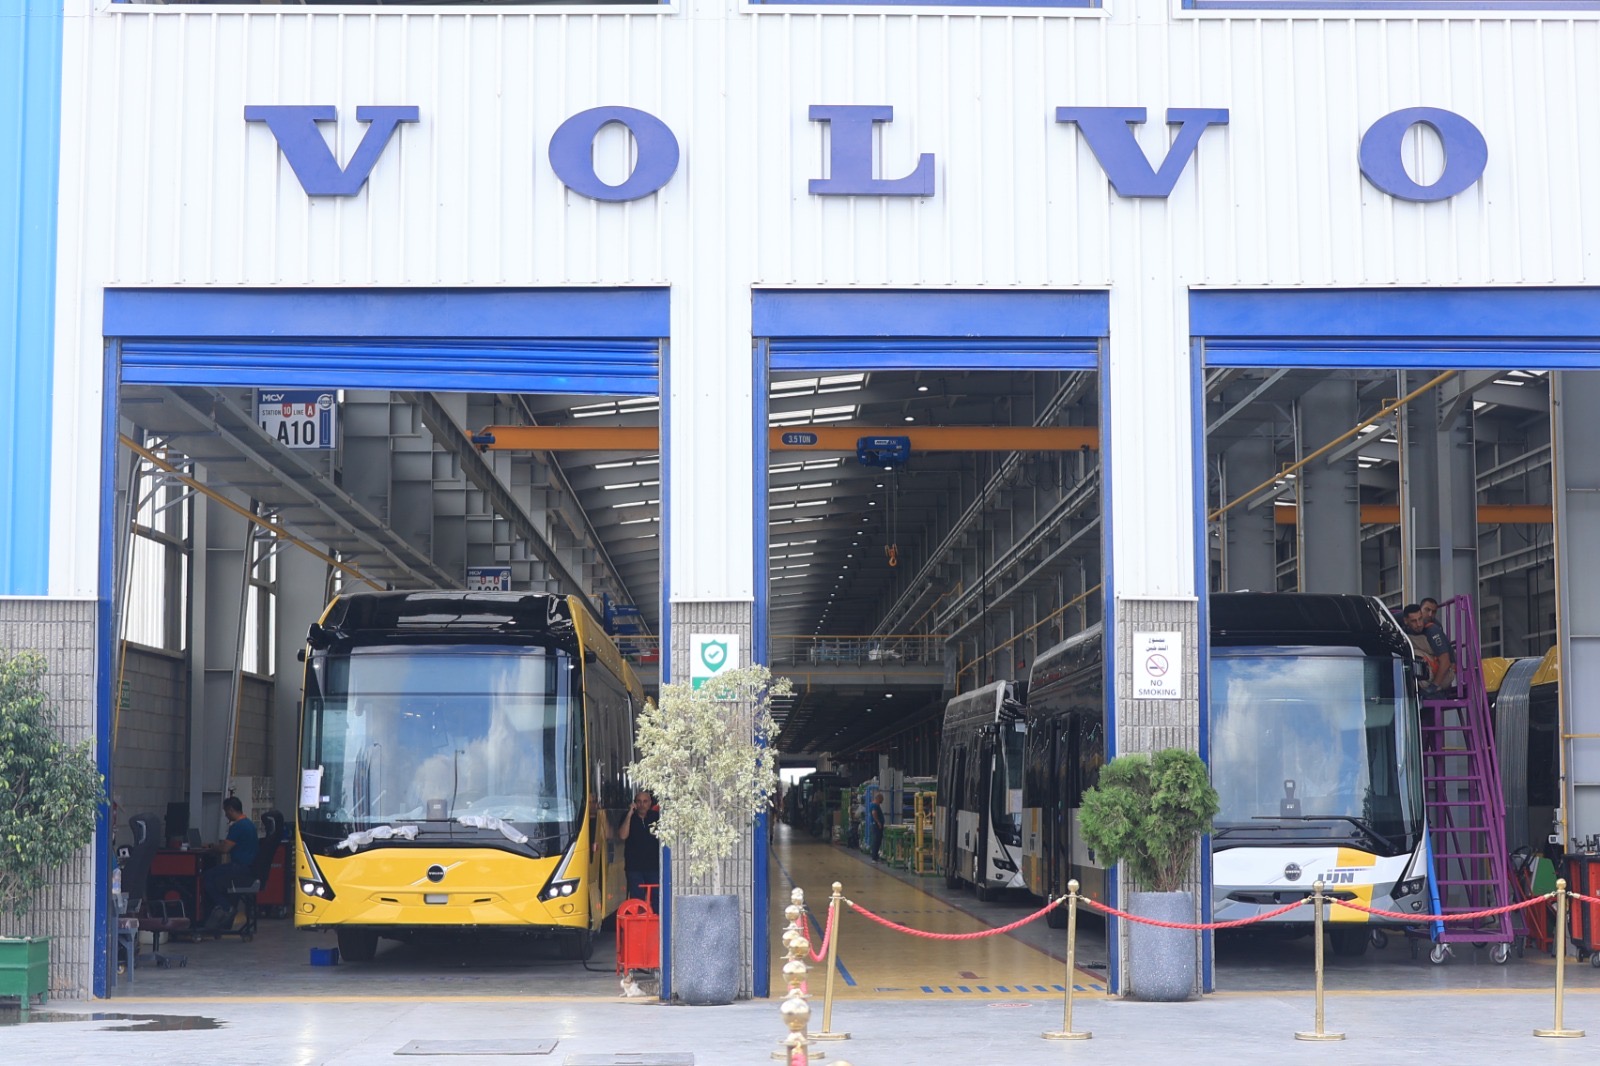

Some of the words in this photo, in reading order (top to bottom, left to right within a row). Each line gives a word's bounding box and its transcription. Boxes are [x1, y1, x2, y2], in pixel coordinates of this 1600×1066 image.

[246, 106, 1487, 201] VOLVO
[284, 406, 290, 414] 10
[307, 405, 314, 415] A
